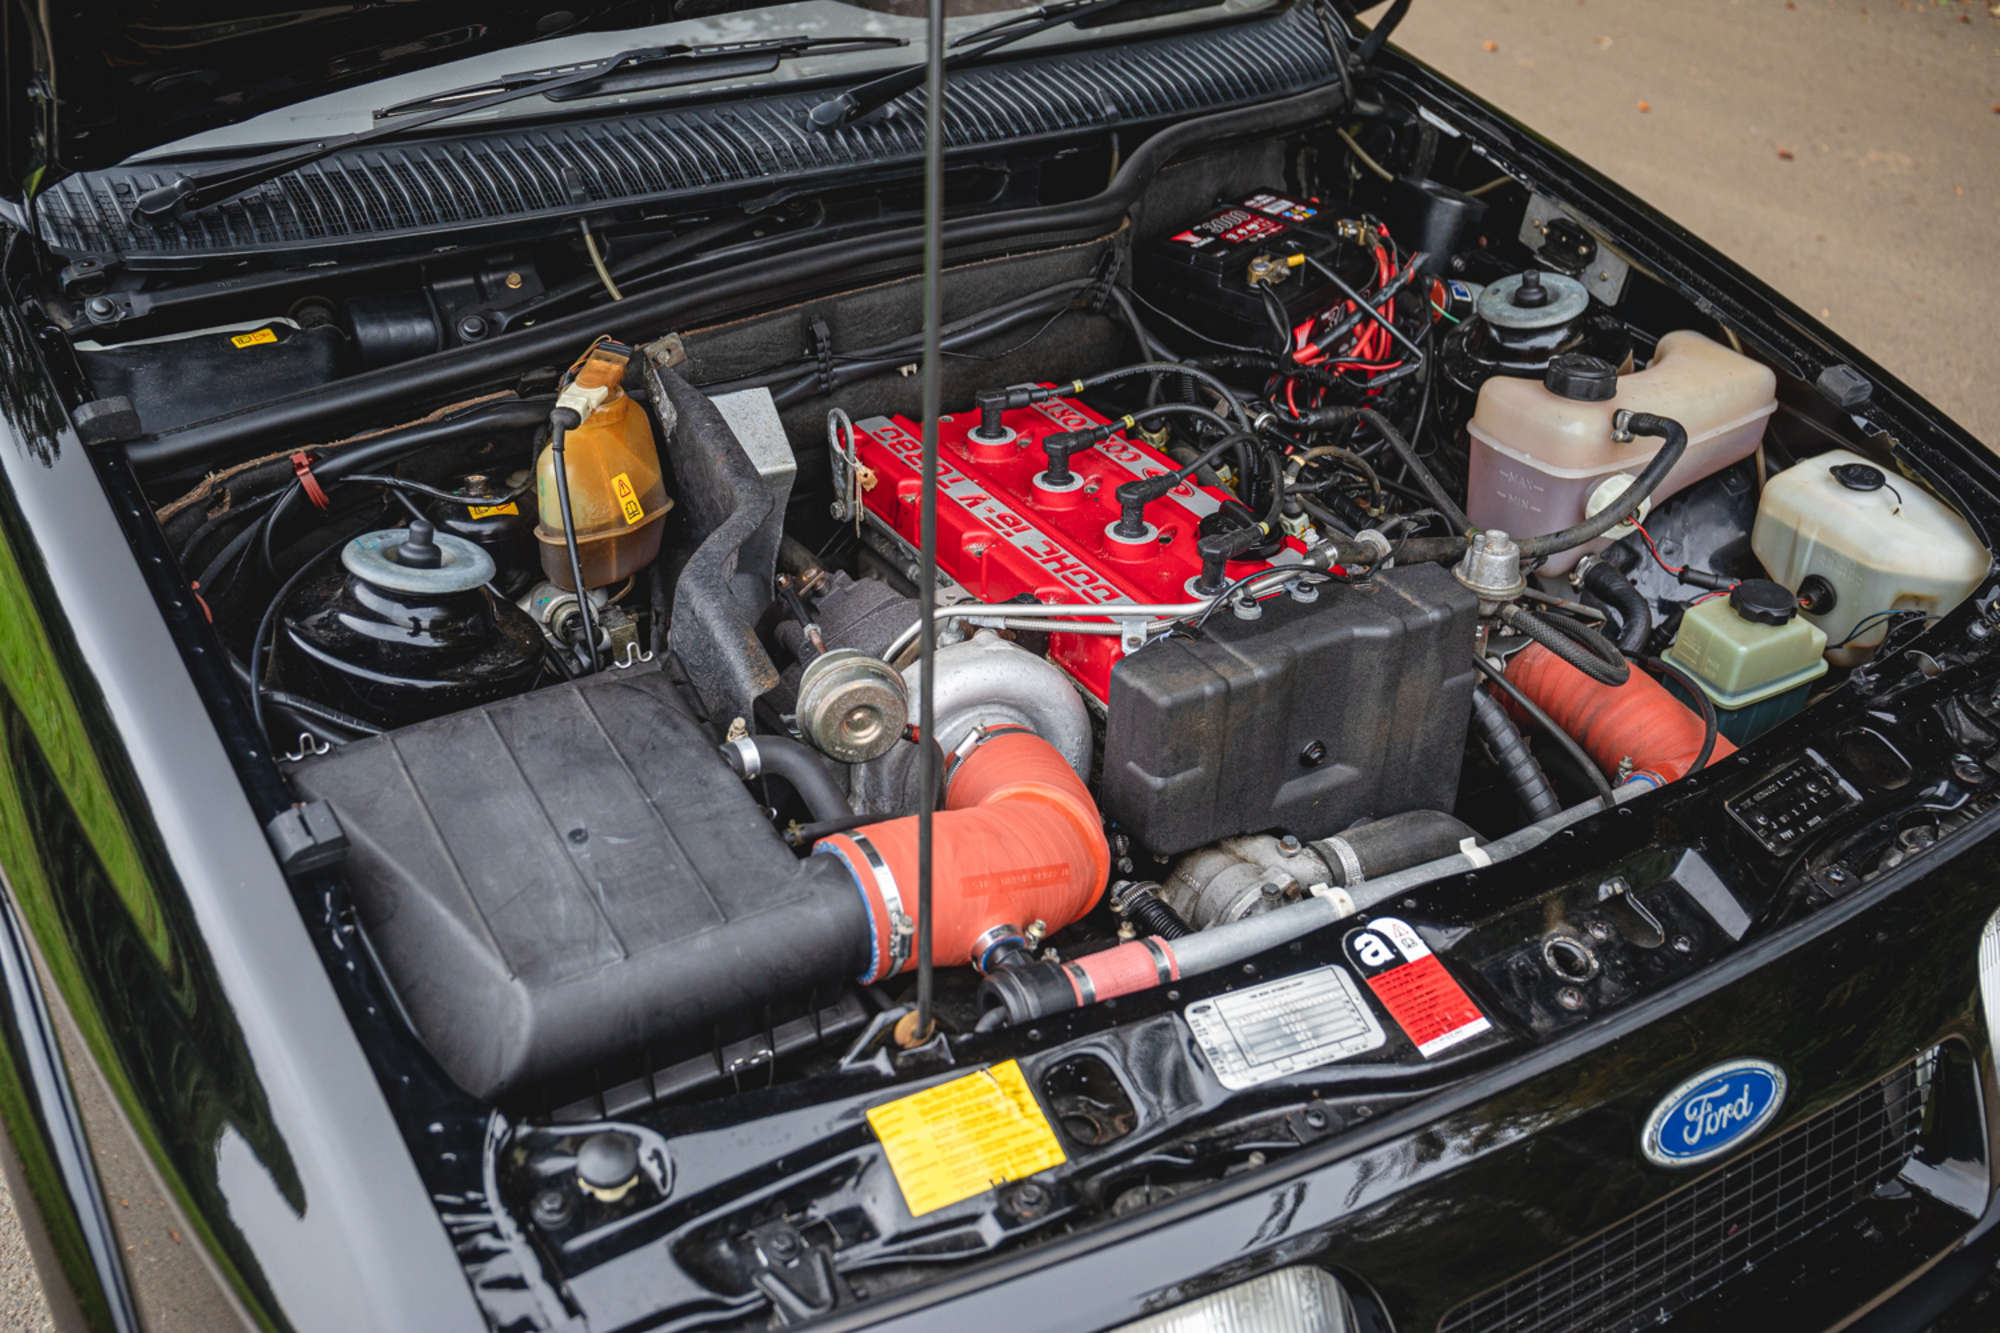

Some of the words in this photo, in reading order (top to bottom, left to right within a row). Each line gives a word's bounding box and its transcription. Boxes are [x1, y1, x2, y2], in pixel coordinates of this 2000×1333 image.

[1033, 397, 1142, 463] COORT
[957, 493, 1033, 539] 16-V
[1021, 538, 1123, 605] DOHC
[1353, 932, 1396, 967] a
[1683, 1083, 1755, 1146] Ford
